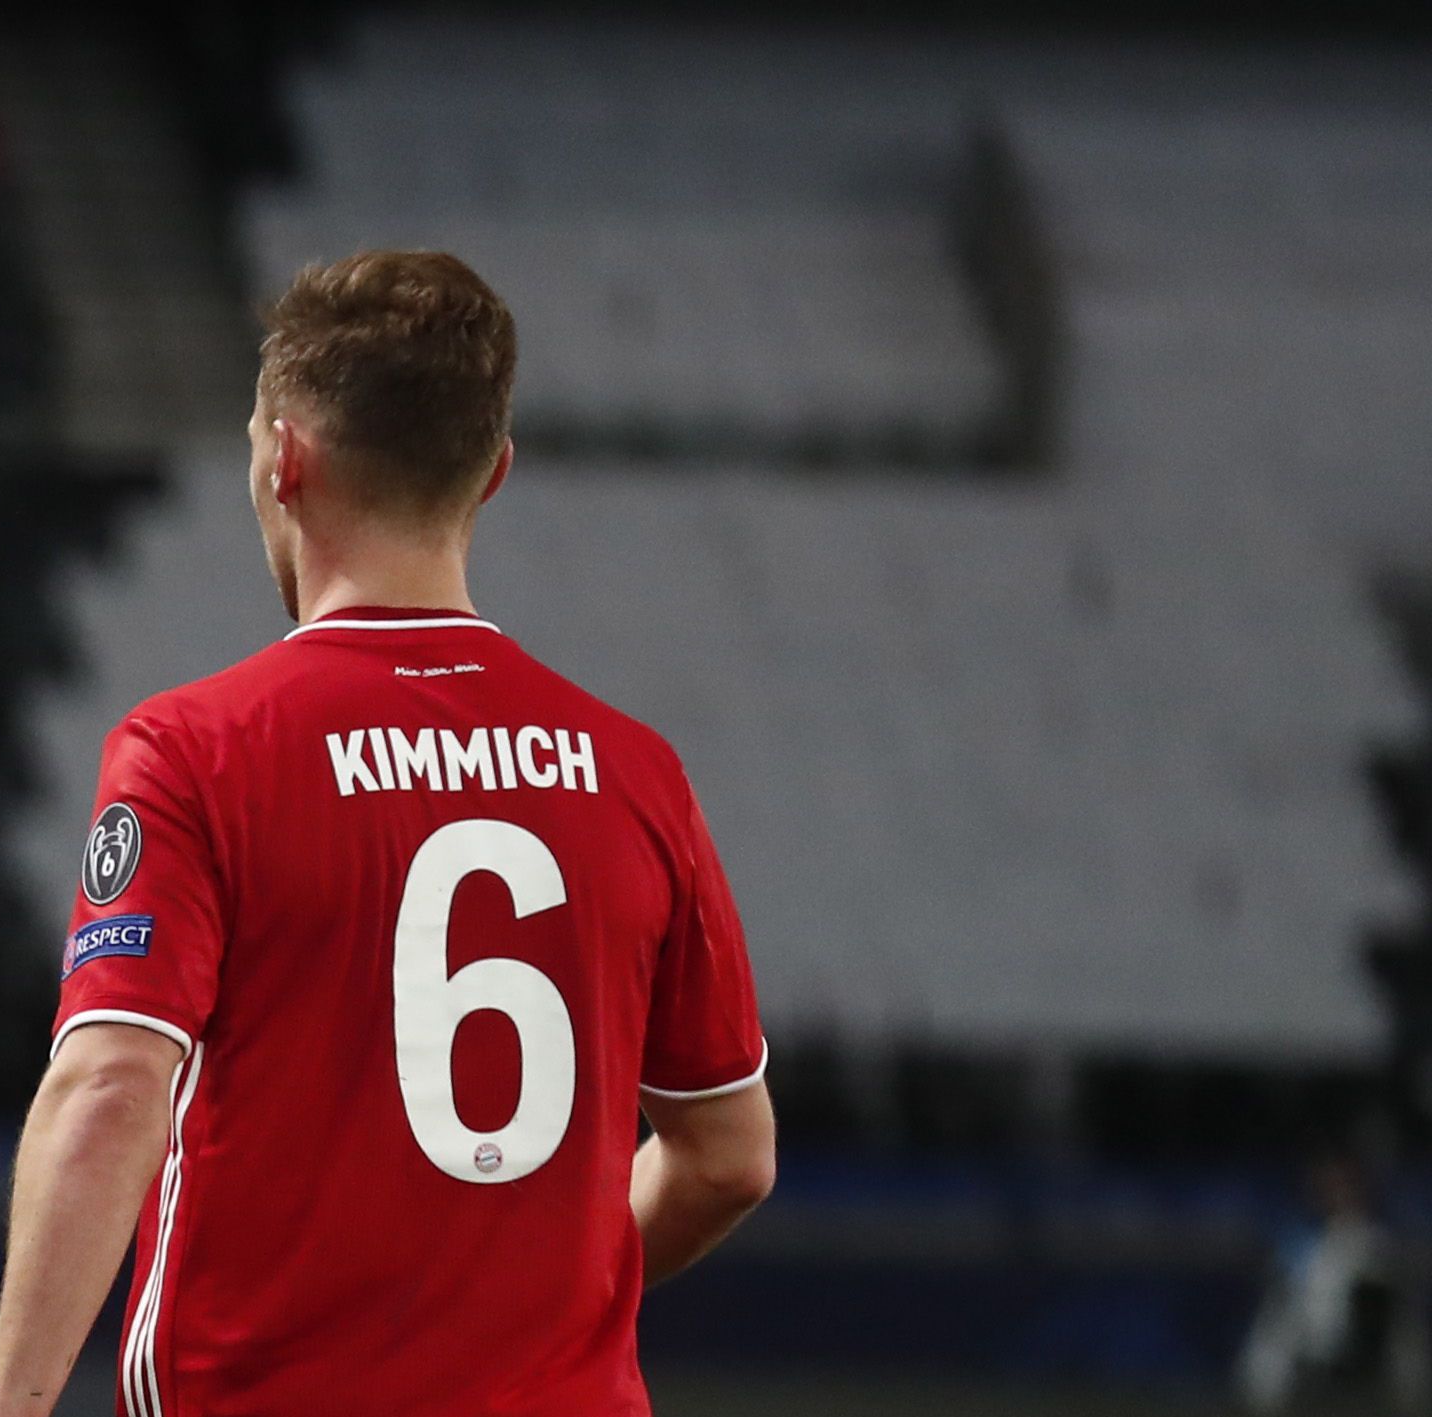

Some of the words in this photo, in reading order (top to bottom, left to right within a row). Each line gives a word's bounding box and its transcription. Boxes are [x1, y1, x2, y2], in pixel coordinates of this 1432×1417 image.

[325, 725, 599, 797] KIMMICH
[101, 852, 116, 877] 6
[76, 926, 153, 957] RESPECT
[392, 818, 576, 1184] 6
